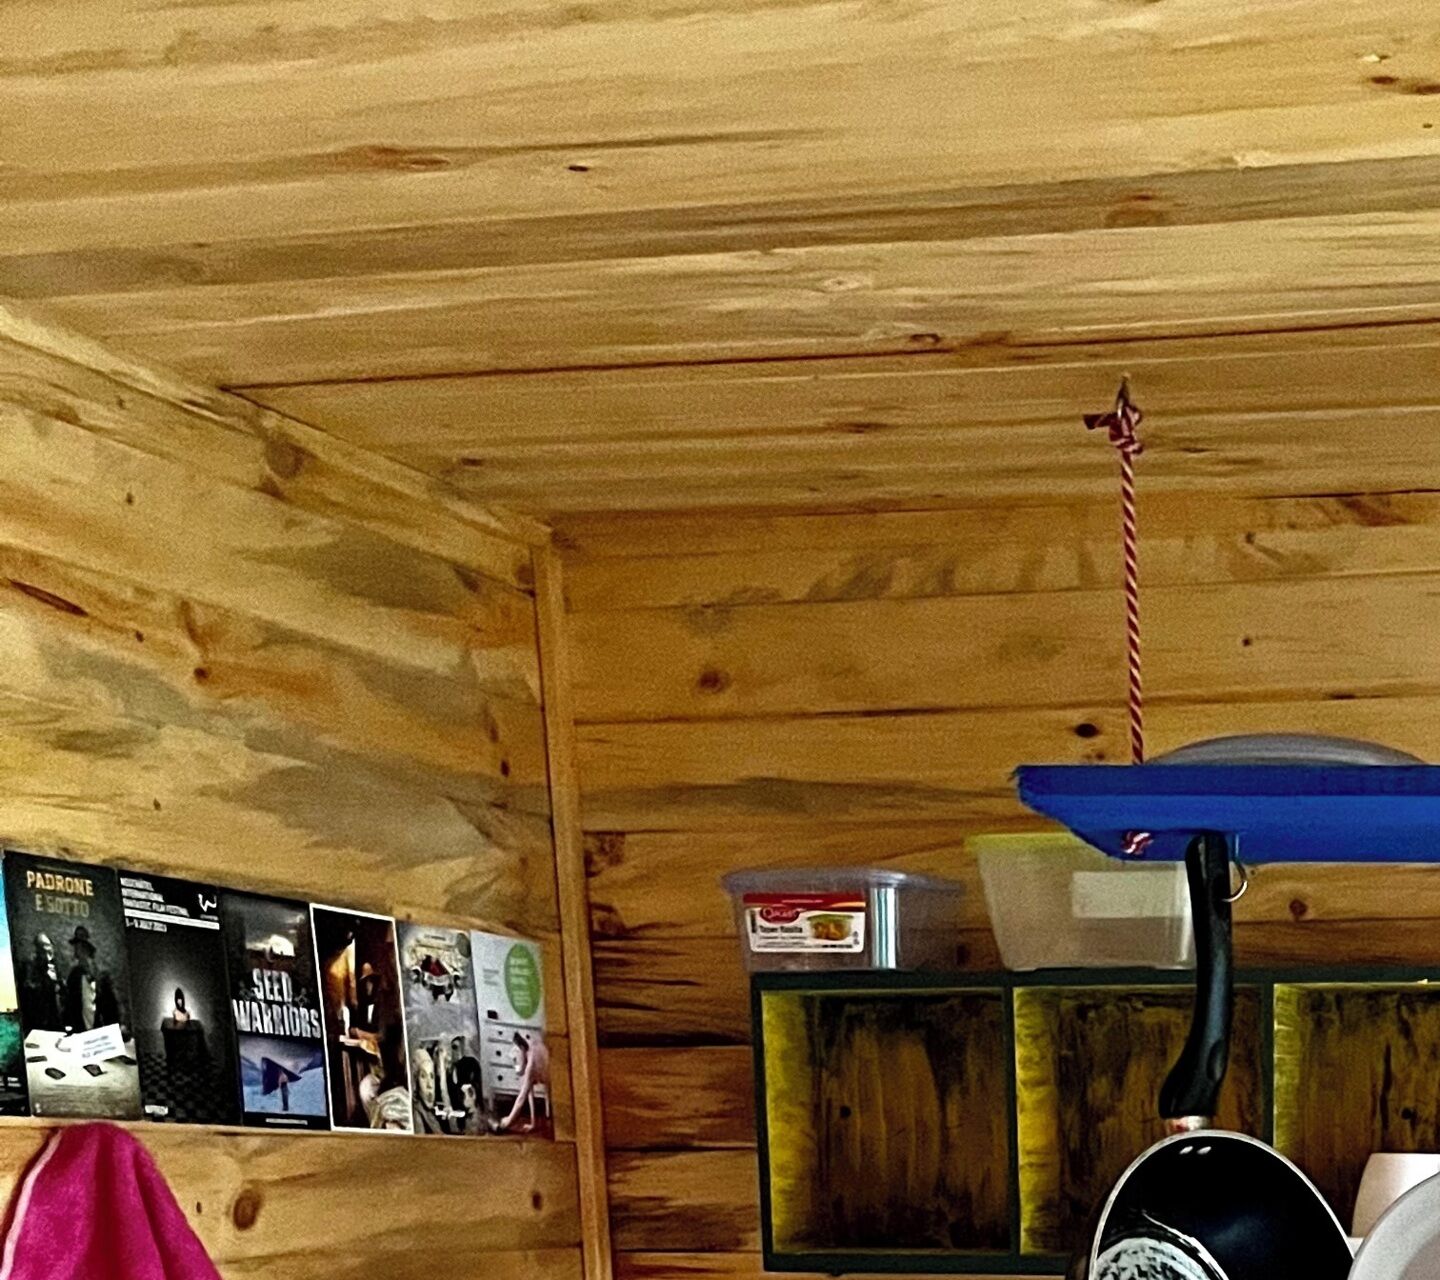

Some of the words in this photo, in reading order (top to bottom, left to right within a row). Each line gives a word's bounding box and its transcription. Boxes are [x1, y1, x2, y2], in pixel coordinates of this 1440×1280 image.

[26, 870, 94, 896] PADRONE
[35, 894, 43, 911] E
[46, 895, 89, 918] SOTTO
[251, 968, 293, 1002] SEED
[232, 999, 321, 1038] WARRIORS
